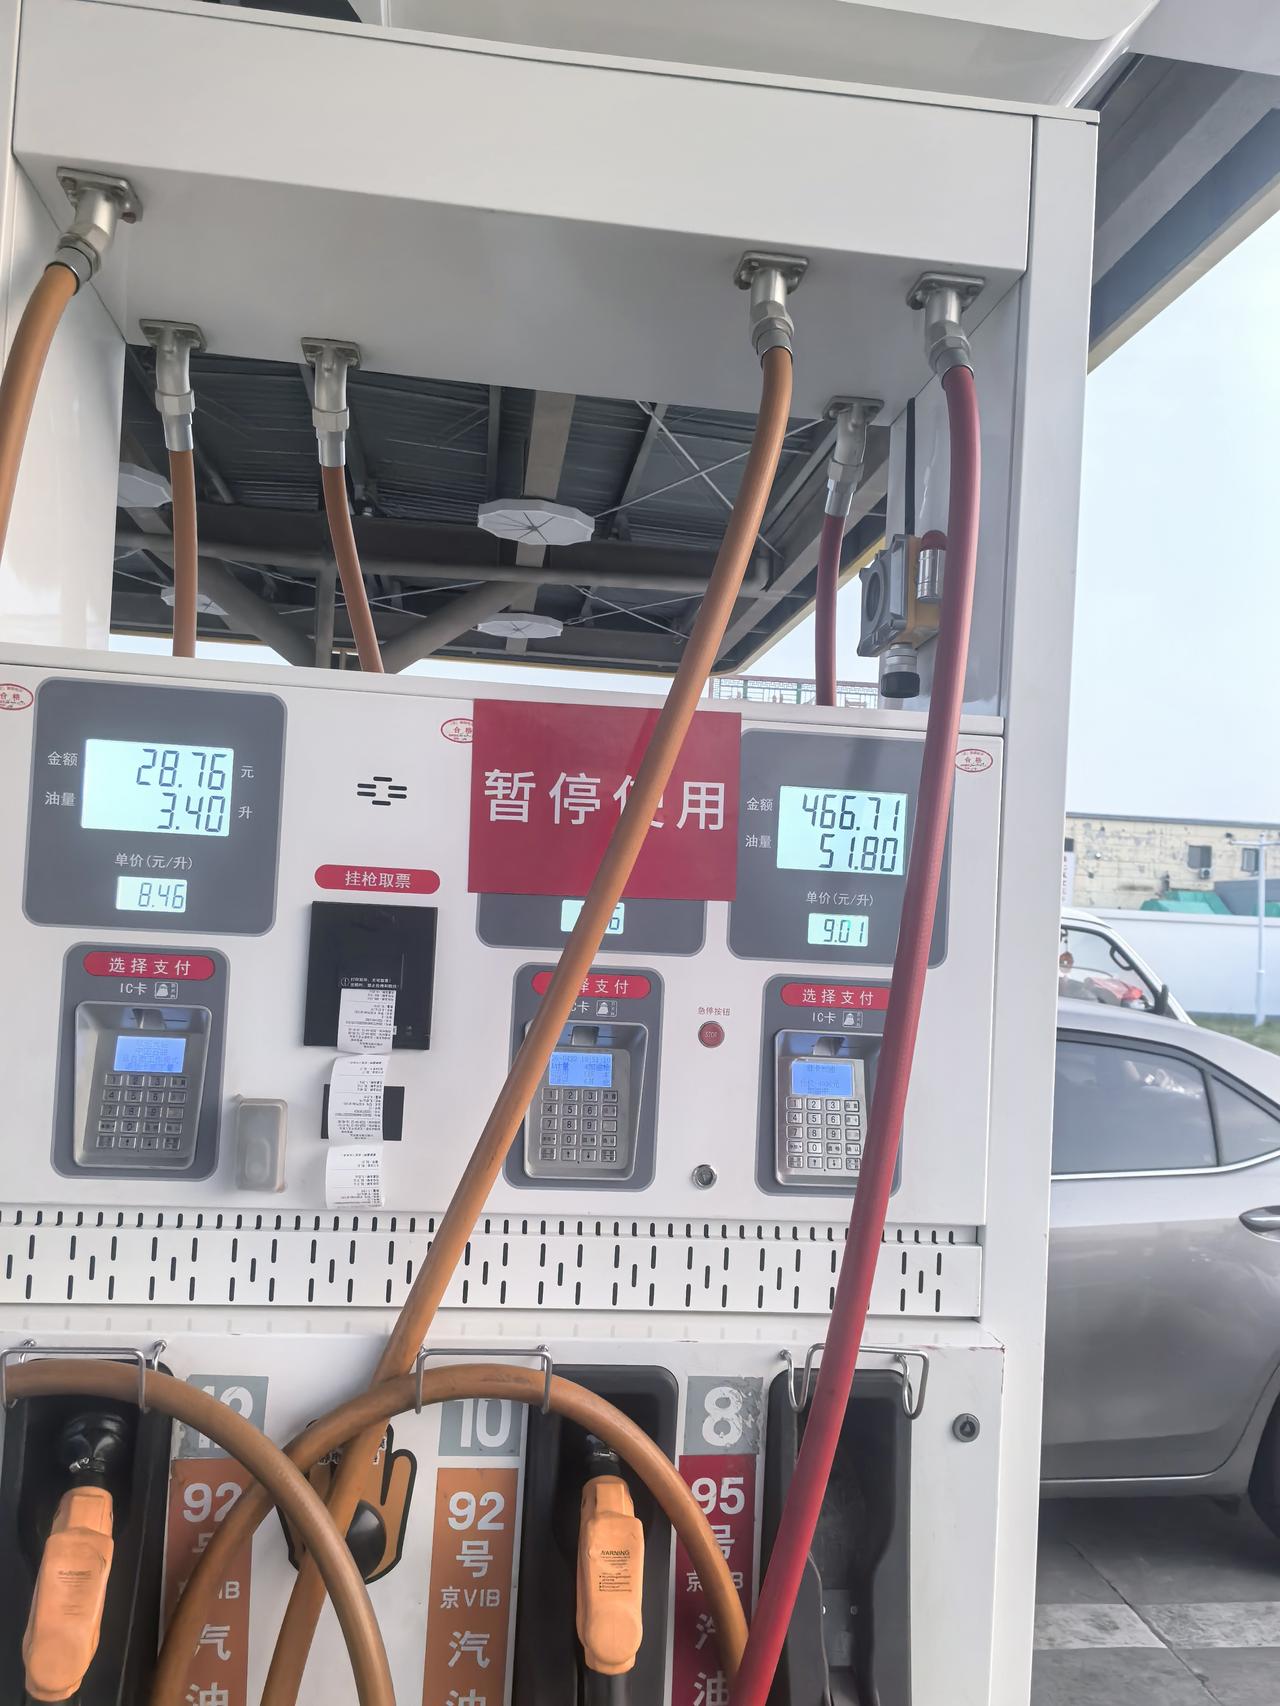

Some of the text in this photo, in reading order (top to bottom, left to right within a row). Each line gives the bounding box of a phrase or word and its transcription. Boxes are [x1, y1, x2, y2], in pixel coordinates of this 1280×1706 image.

[47, 751, 78, 767] 金额
[136, 748, 228, 791] 28.76
[241, 765, 254, 778] 元
[44, 791, 76, 807] 油量
[746, 798, 773, 812] 金额
[156, 792, 226, 833] 3.40
[238, 806, 252, 819] 升
[802, 793, 901, 832] 466.71
[745, 835, 772, 849] 油量
[114, 853, 193, 870] 单价(元/升)
[818, 833, 898, 873] 51.80
[345, 870, 412, 889] 挂枪取票
[137, 882, 185, 909] 8.46
[806, 891, 874, 907] 单价(元/升)
[823, 918, 865, 944] 9.01
[108, 957, 191, 976] 选择支付
[120, 982, 148, 996] IC卡
[580, 978, 629, 995] 支付
[802, 988, 874, 1006] 选择支付
[812, 1011, 837, 1024] IC卡
[459, 1399, 512, 1447] 10
[702, 1386, 743, 1446] 8
[183, 1482, 242, 1522] 92
[691, 1477, 745, 1515] 95
[448, 1491, 504, 1531] 92
[456, 1540, 493, 1578] 号
